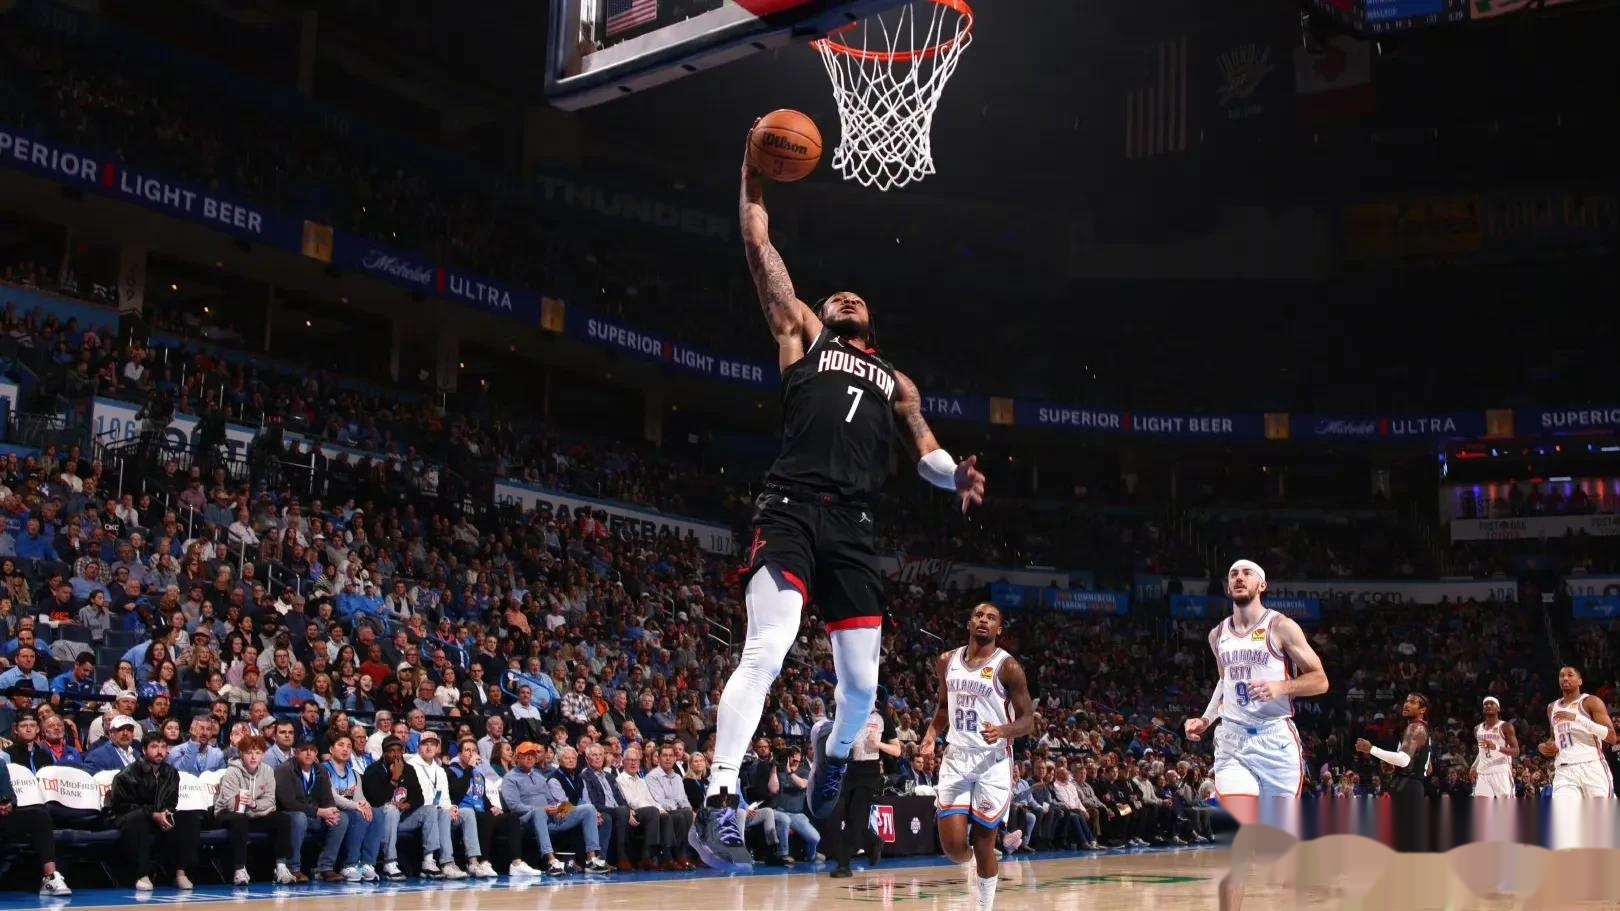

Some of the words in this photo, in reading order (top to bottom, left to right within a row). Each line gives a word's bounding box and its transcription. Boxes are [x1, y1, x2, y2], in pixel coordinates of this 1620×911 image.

[761, 132, 808, 155] Wilson
[121, 171, 197, 212] LIGHT
[203, 197, 263, 234] BEER
[449, 274, 512, 312] ULTRA
[587, 319, 662, 358] SUPERIOR
[673, 347, 714, 372] LIGHT
[720, 359, 763, 383] BEER
[818, 350, 895, 401] HOUSTON
[845, 385, 864, 423] 7
[97, 415, 136, 441] 106
[1039, 408, 1120, 428] SUPERIOR
[1133, 417, 1183, 432] LIGHT
[1190, 418, 1233, 433] BEER
[1393, 417, 1456, 433] ULTRA
[1229, 666, 1252, 681] CITY
[1235, 681, 1250, 707] 9
[955, 708, 977, 733] 22
[1559, 733, 1573, 749] 21
